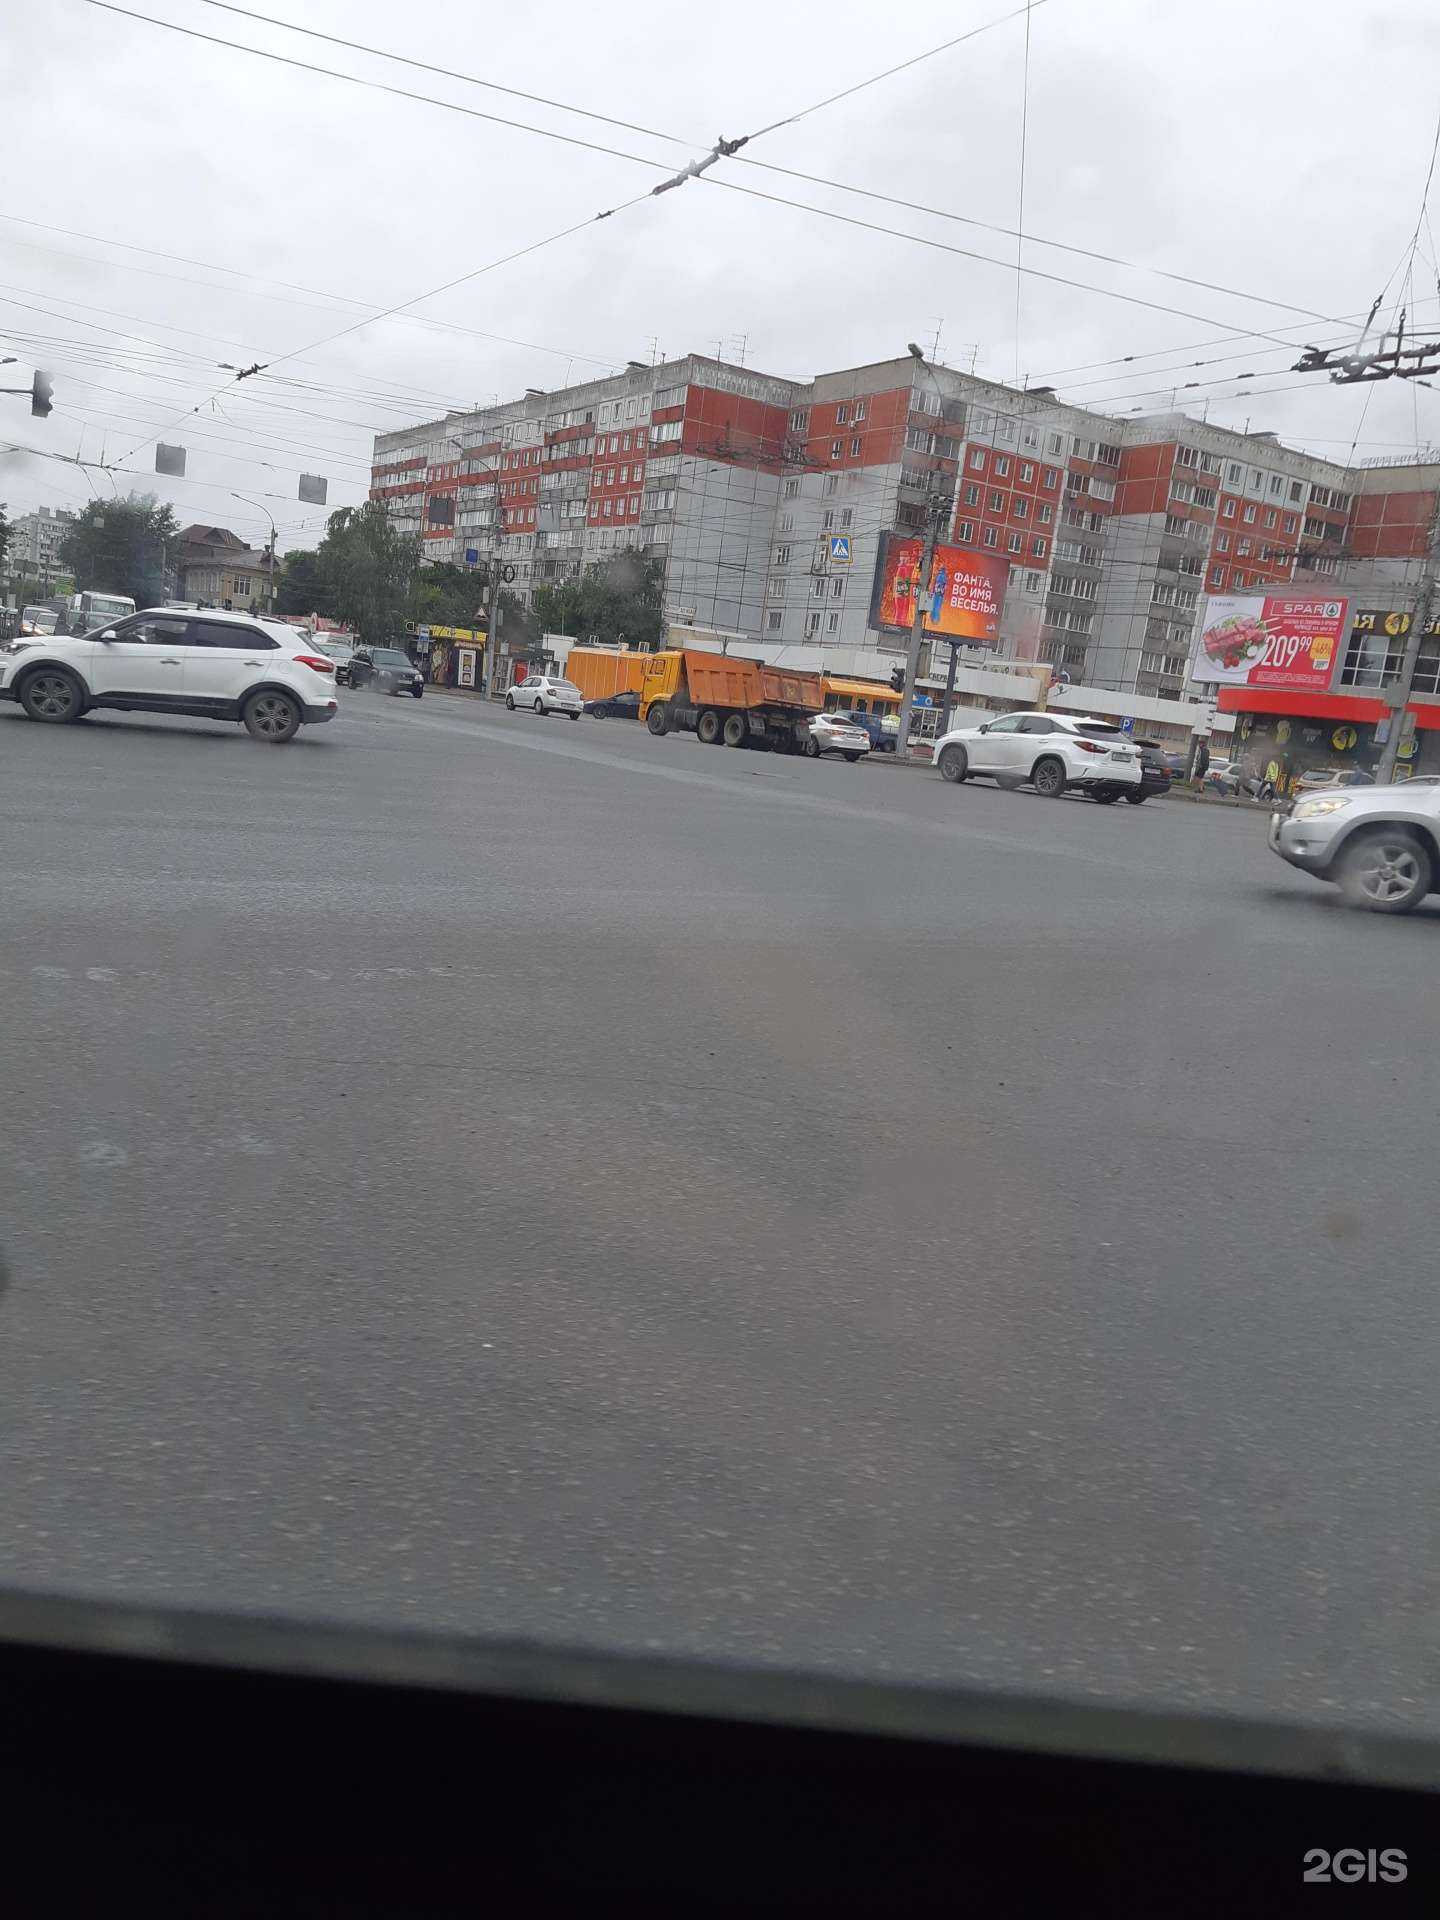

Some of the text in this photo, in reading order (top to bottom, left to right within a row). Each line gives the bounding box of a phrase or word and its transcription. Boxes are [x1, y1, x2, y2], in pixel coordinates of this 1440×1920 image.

[954, 572, 993, 589] ФАНТА.
[952, 584, 968, 597] ВО
[969, 587, 992, 601] ИМЯ
[950, 596, 999, 615] ВЕСЕЛЬЯ.
[1283, 603, 1324, 615] SPAR
